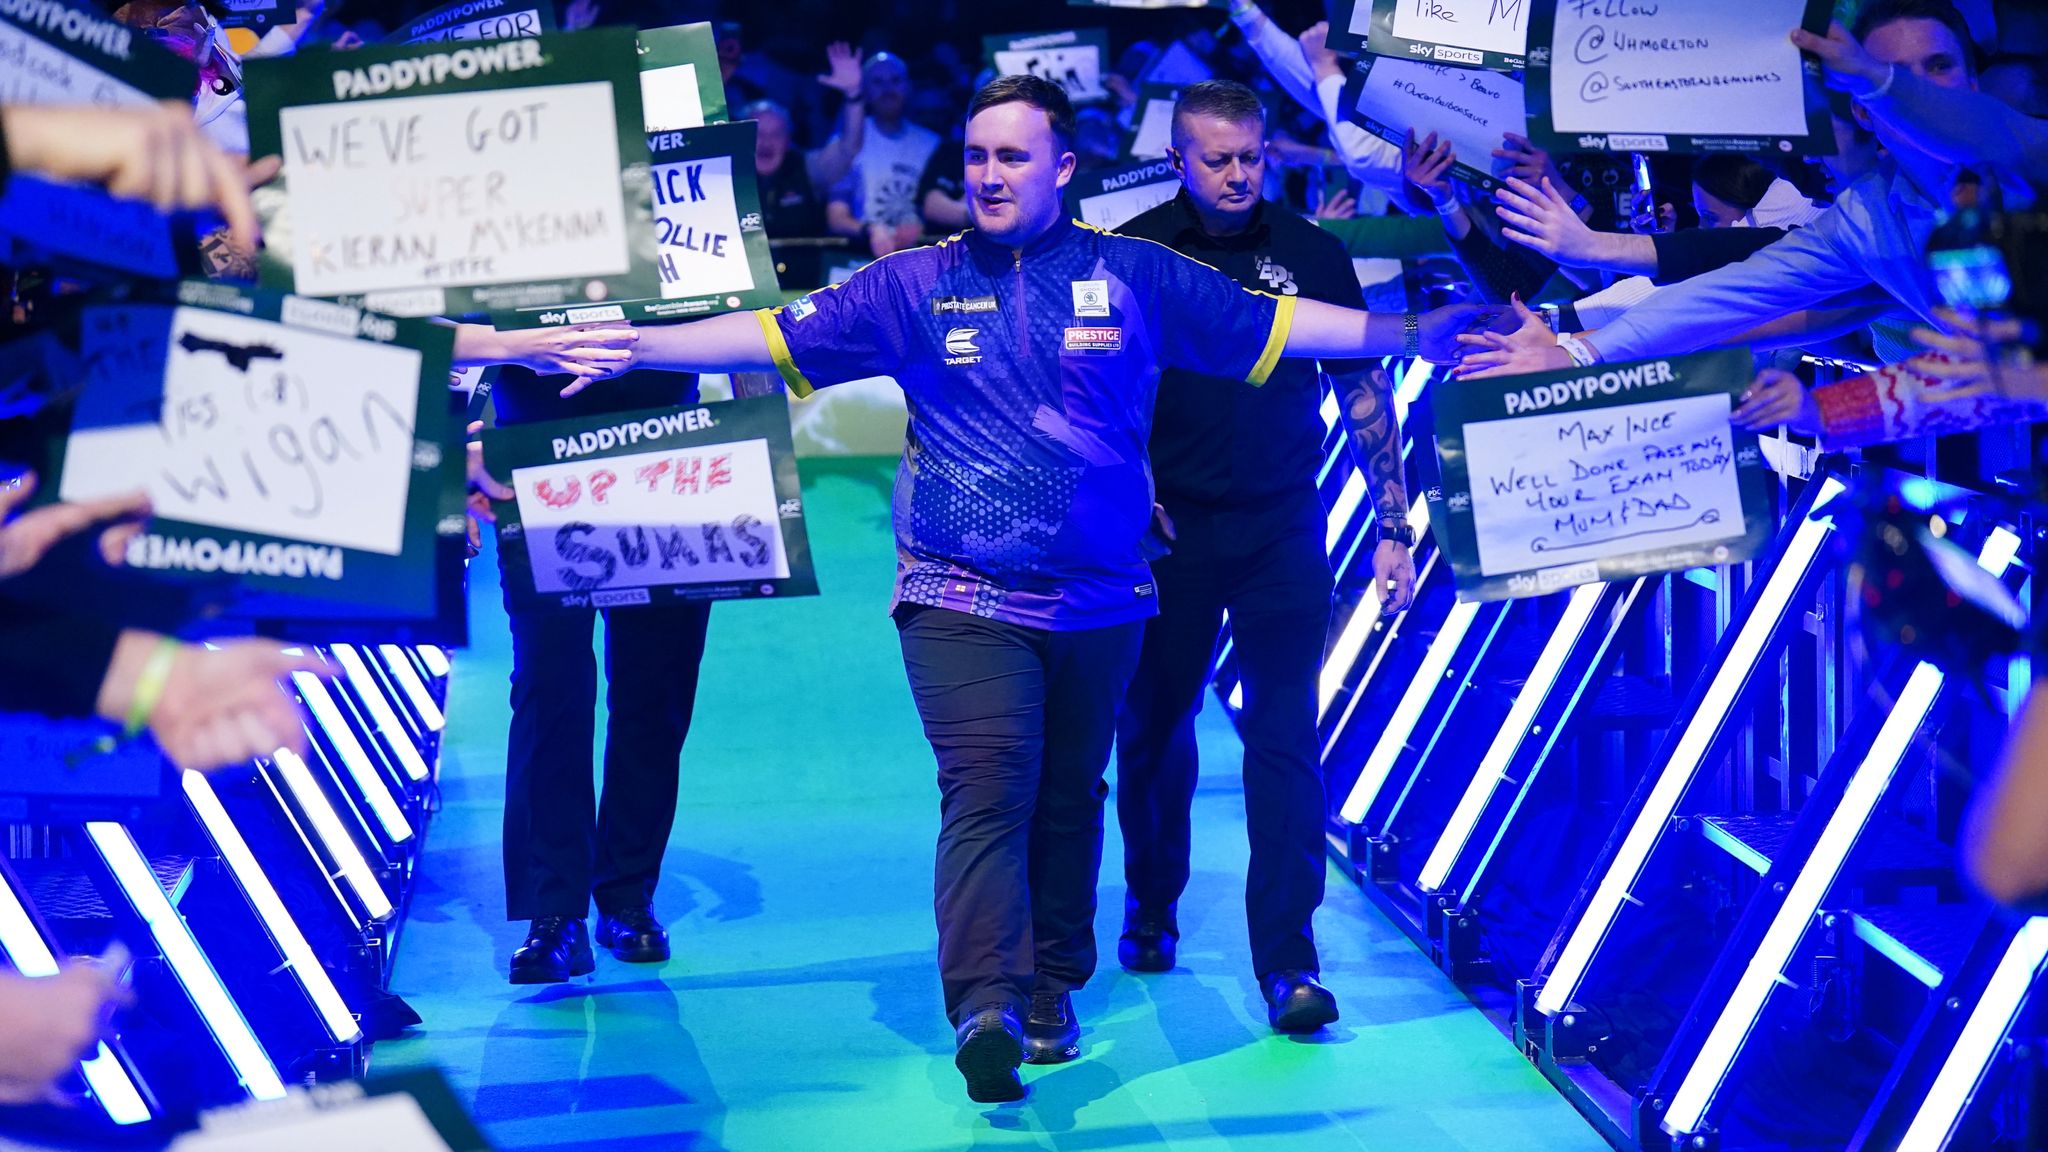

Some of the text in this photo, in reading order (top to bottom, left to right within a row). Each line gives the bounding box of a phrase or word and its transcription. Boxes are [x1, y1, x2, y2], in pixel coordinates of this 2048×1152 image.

[1409, 43, 1481, 62] sky sports
[464, 100, 552, 156] GOT
[393, 169, 510, 224] SUPER
[310, 232, 440, 278] KIERAN
[540, 308, 620, 325] sky sports
[1068, 330, 1120, 341] PRESTIGE
[944, 356, 982, 365] TARGET
[532, 453, 733, 511] UP THE
[1491, 468, 1558, 497] WELL
[1609, 469, 1674, 494] EXAM
